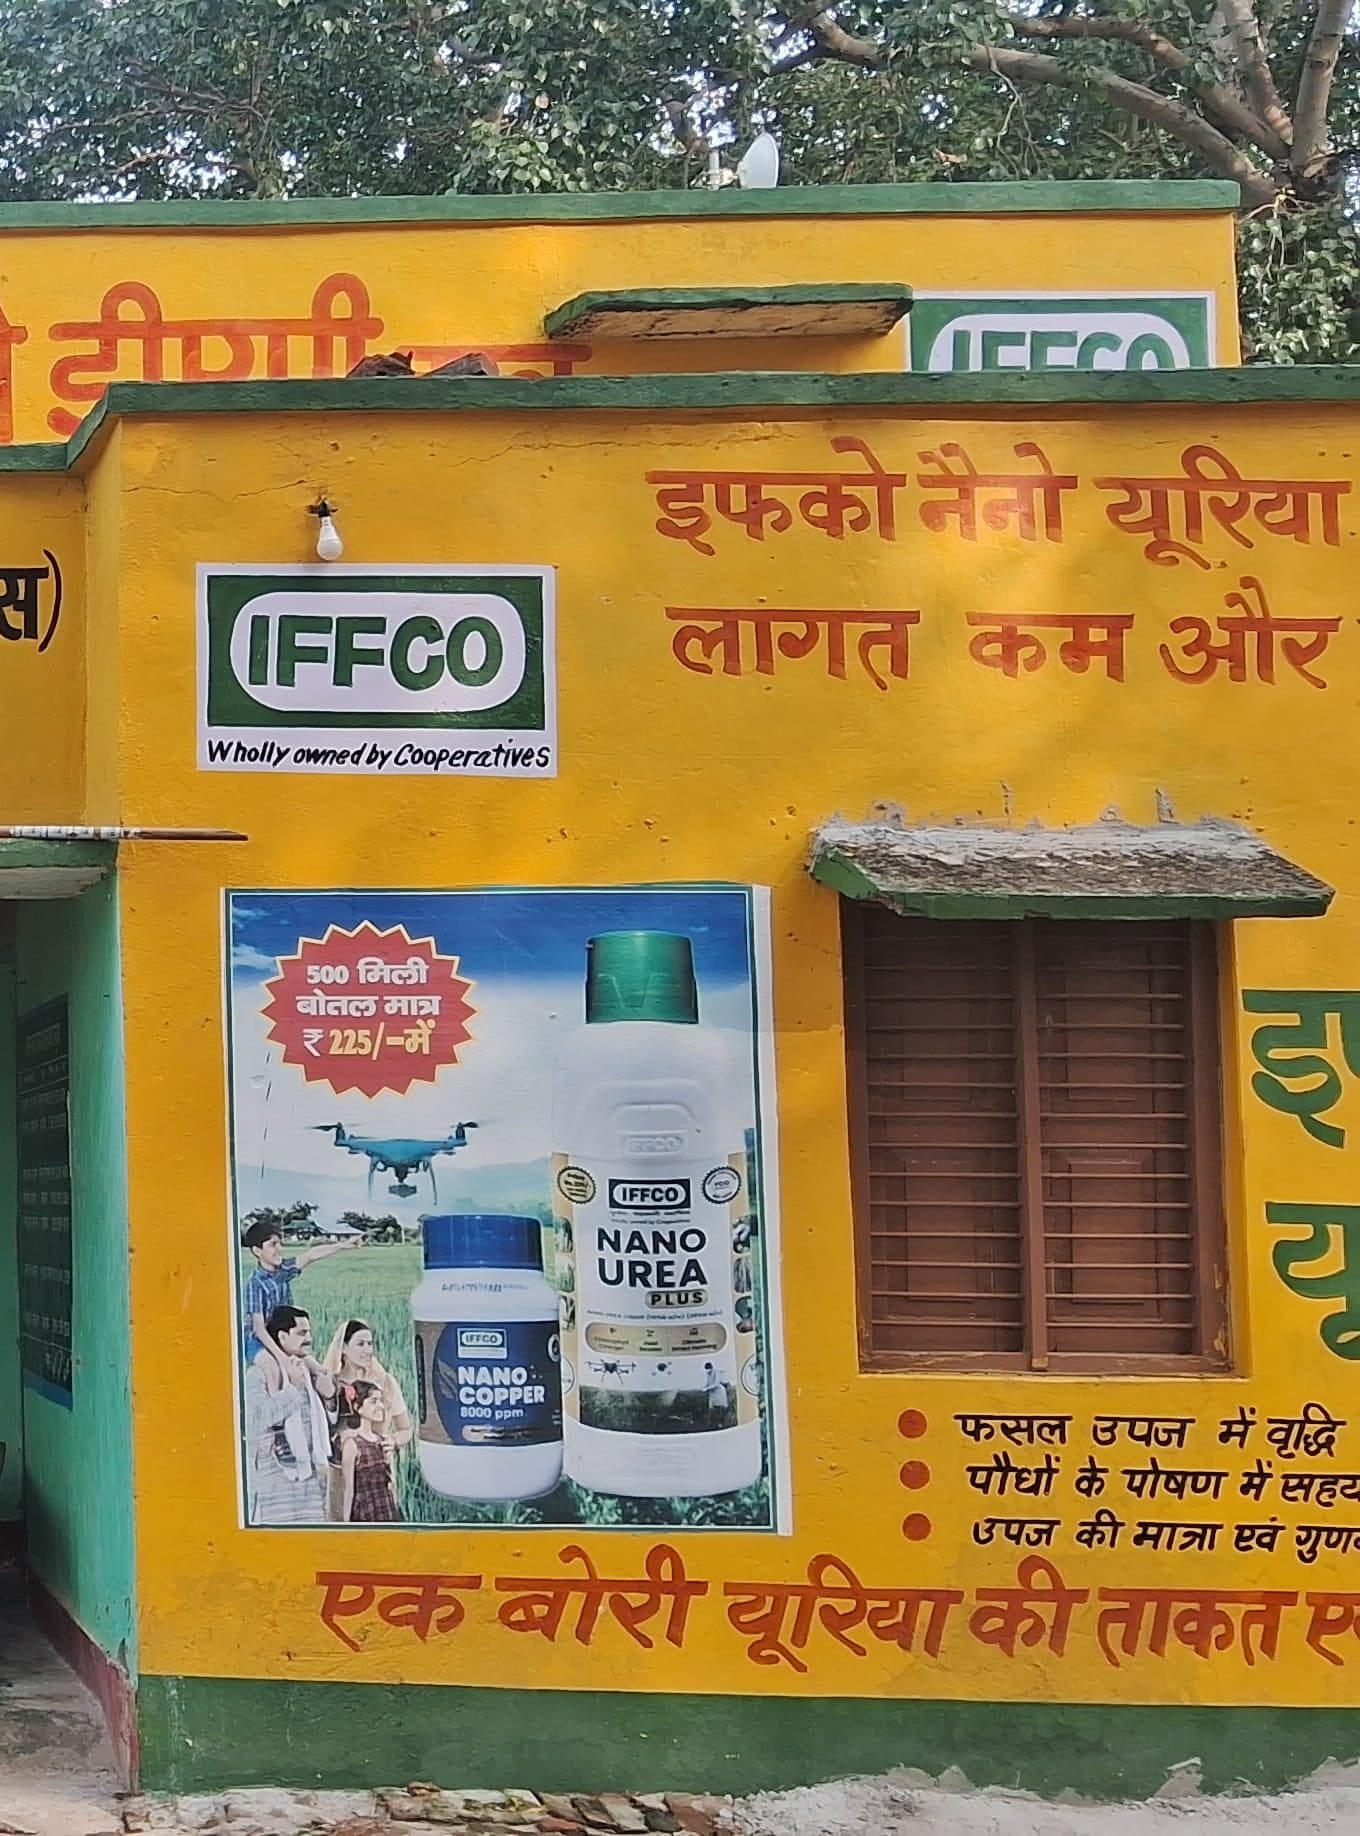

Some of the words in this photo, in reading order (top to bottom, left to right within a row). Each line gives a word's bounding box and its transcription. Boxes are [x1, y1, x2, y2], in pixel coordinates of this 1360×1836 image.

[644, 436, 908, 557] इफको
[917, 441, 1080, 543] नैनो
[1092, 443, 1354, 571] यूरिया
[664, 605, 921, 692] लागत
[965, 611, 1136, 684] कम
[1158, 575, 1344, 690] और
[245, 612, 504, 692] IFFCO
[206, 739, 290, 768] Wholly
[292, 742, 366, 766] owned
[365, 743, 391, 770] by
[392, 738, 552, 771] Cooperatives
[305, 964, 351, 986] 500
[355, 956, 431, 986] मिली
[294, 987, 381, 1018] बोतल
[382, 994, 443, 1017] मात्र
[301, 1027, 326, 1058] ₹
[621, 1186, 680, 1203] IFFCO
[596, 1226, 708, 1256] NANO
[597, 1256, 709, 1290] UREA
[650, 1291, 705, 1307] PLUS
[464, 1333, 499, 1344] IFFCO
[457, 1365, 529, 1386] NANO
[458, 1385, 546, 1406] COPPER
[459, 1406, 493, 1419] 8000
[493, 1408, 526, 1421] ppm
[953, 1413, 1074, 1447] फसल
[1091, 1415, 1197, 1449] उपज
[1218, 1406, 1258, 1450] में
[1266, 1402, 1348, 1460] वृद्धि
[966, 1450, 1061, 1497] पौधों
[1074, 1454, 1110, 1498] के
[1120, 1456, 1230, 1501] पोषण
[1239, 1458, 1274, 1502] में
[972, 1517, 1062, 1547] उपज
[1075, 1508, 1126, 1549] की
[1132, 1521, 1225, 1552] मात्रा
[1233, 1516, 1287, 1553] एवं
[1295, 1525, 1360, 1564] गुण
[316, 1572, 483, 1653] एक
[494, 1544, 710, 1650] बोरी
[723, 1553, 964, 1674] यूरिया
[970, 1555, 1089, 1659] की
[1096, 1589, 1299, 1667] ताकत
[1304, 1591, 1360, 1667] ए
